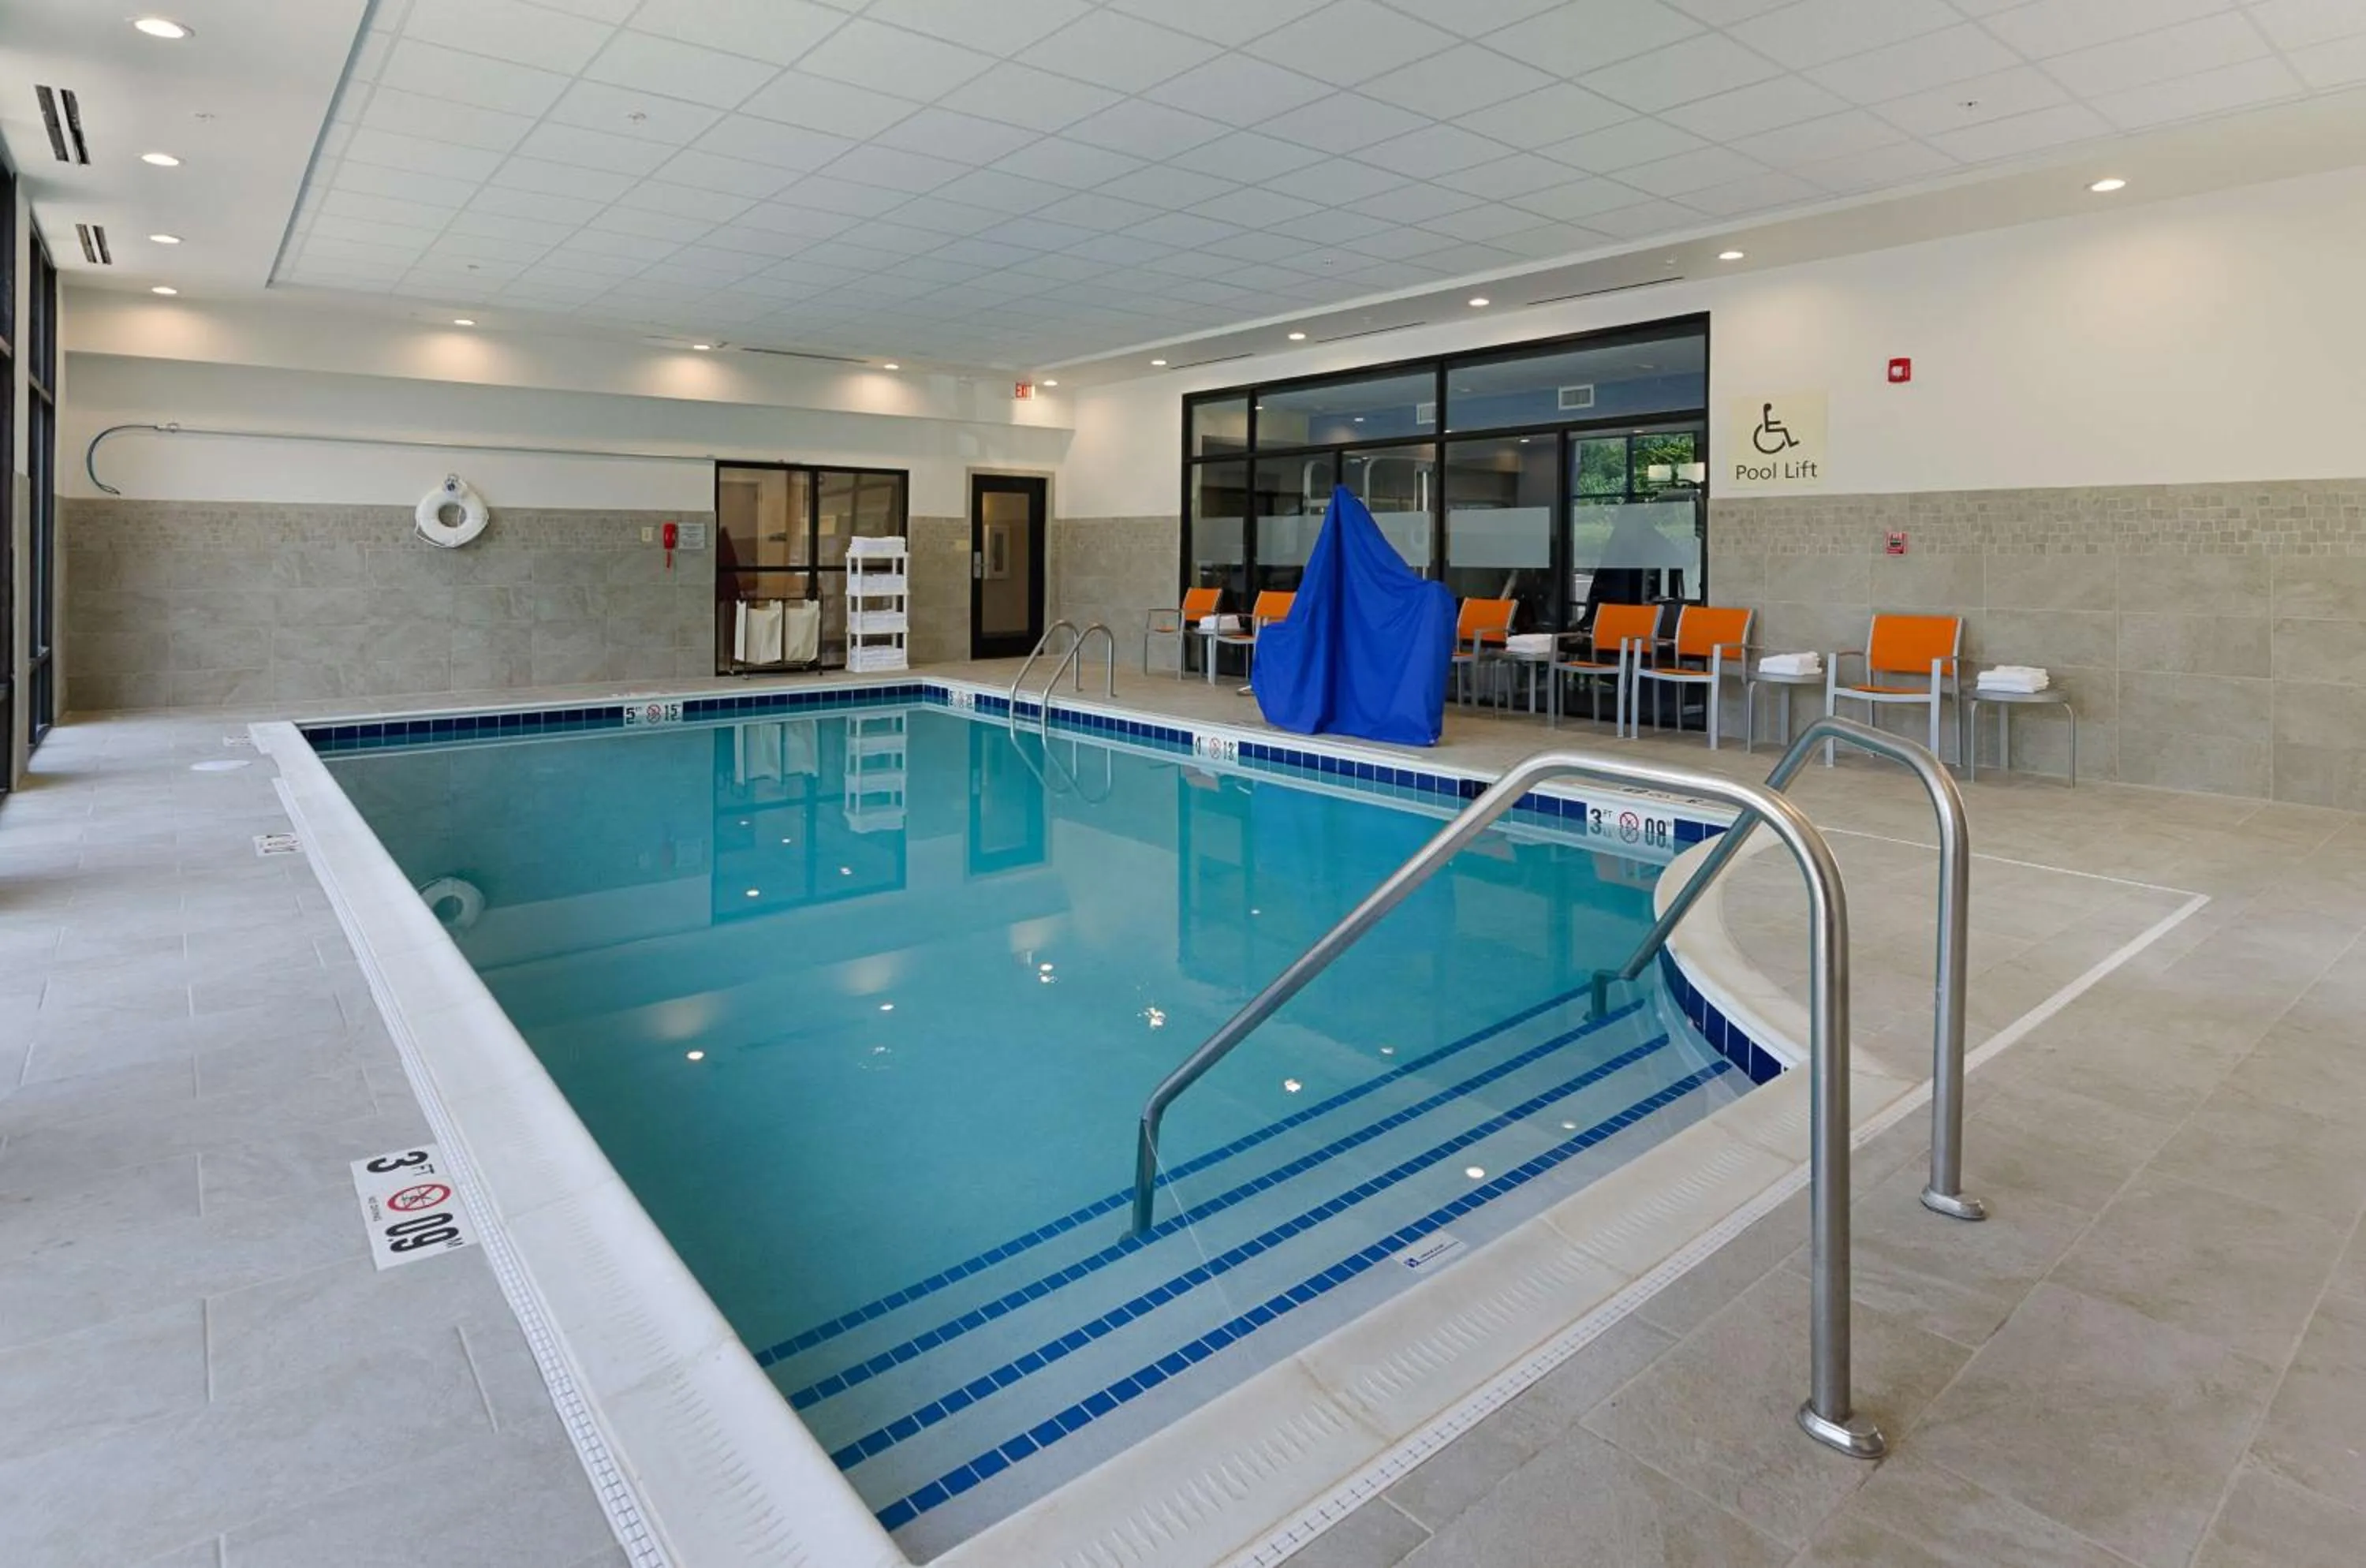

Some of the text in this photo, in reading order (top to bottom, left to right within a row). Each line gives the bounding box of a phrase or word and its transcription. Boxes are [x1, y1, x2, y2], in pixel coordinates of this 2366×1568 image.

[1736, 461, 1817, 480] Pool Lift
[367, 1152, 435, 1176] 3 FT
